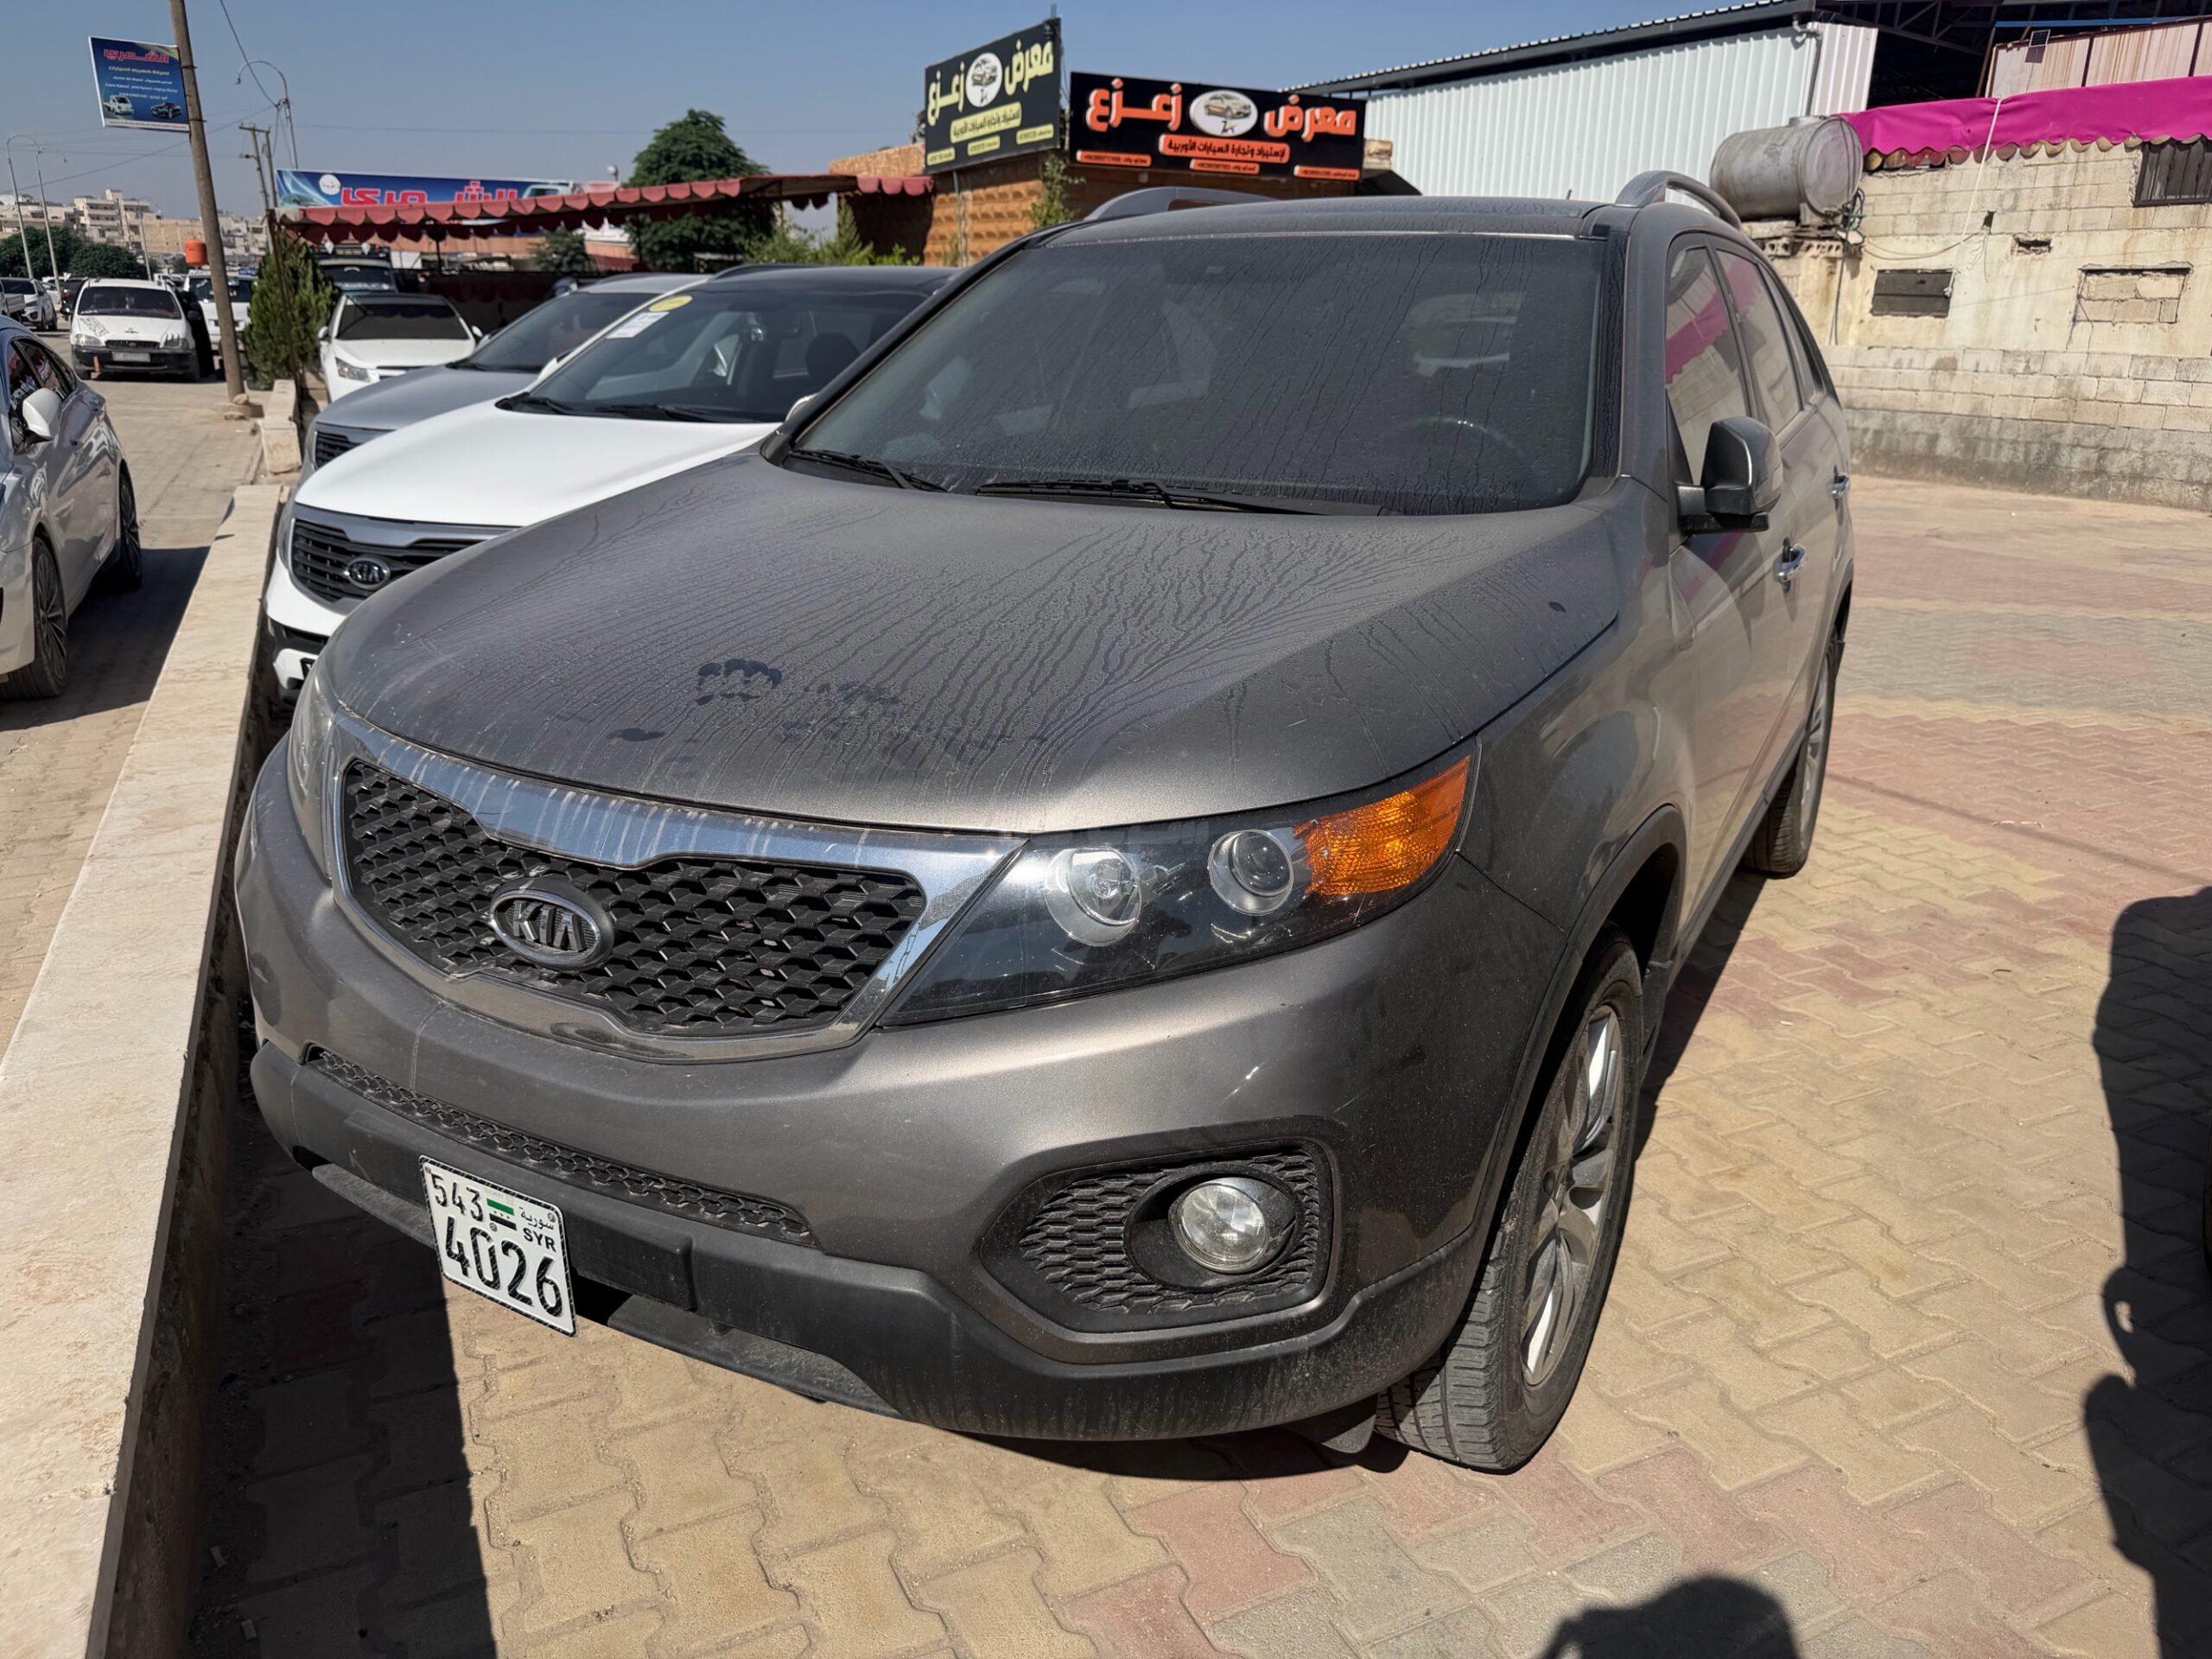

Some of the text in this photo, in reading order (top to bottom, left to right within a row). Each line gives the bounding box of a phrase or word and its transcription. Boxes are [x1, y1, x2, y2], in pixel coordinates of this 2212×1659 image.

[927, 39, 1054, 127] معرض زعزع
[1085, 78, 1357, 143] معرض زعزع
[1198, 142, 1229, 156] السيارات
[512, 900, 588, 952] KIA
[430, 1173, 484, 1222] 543
[518, 1206, 555, 1230] سورية
[523, 1227, 556, 1252] SYR
[445, 1216, 563, 1317] 4026
